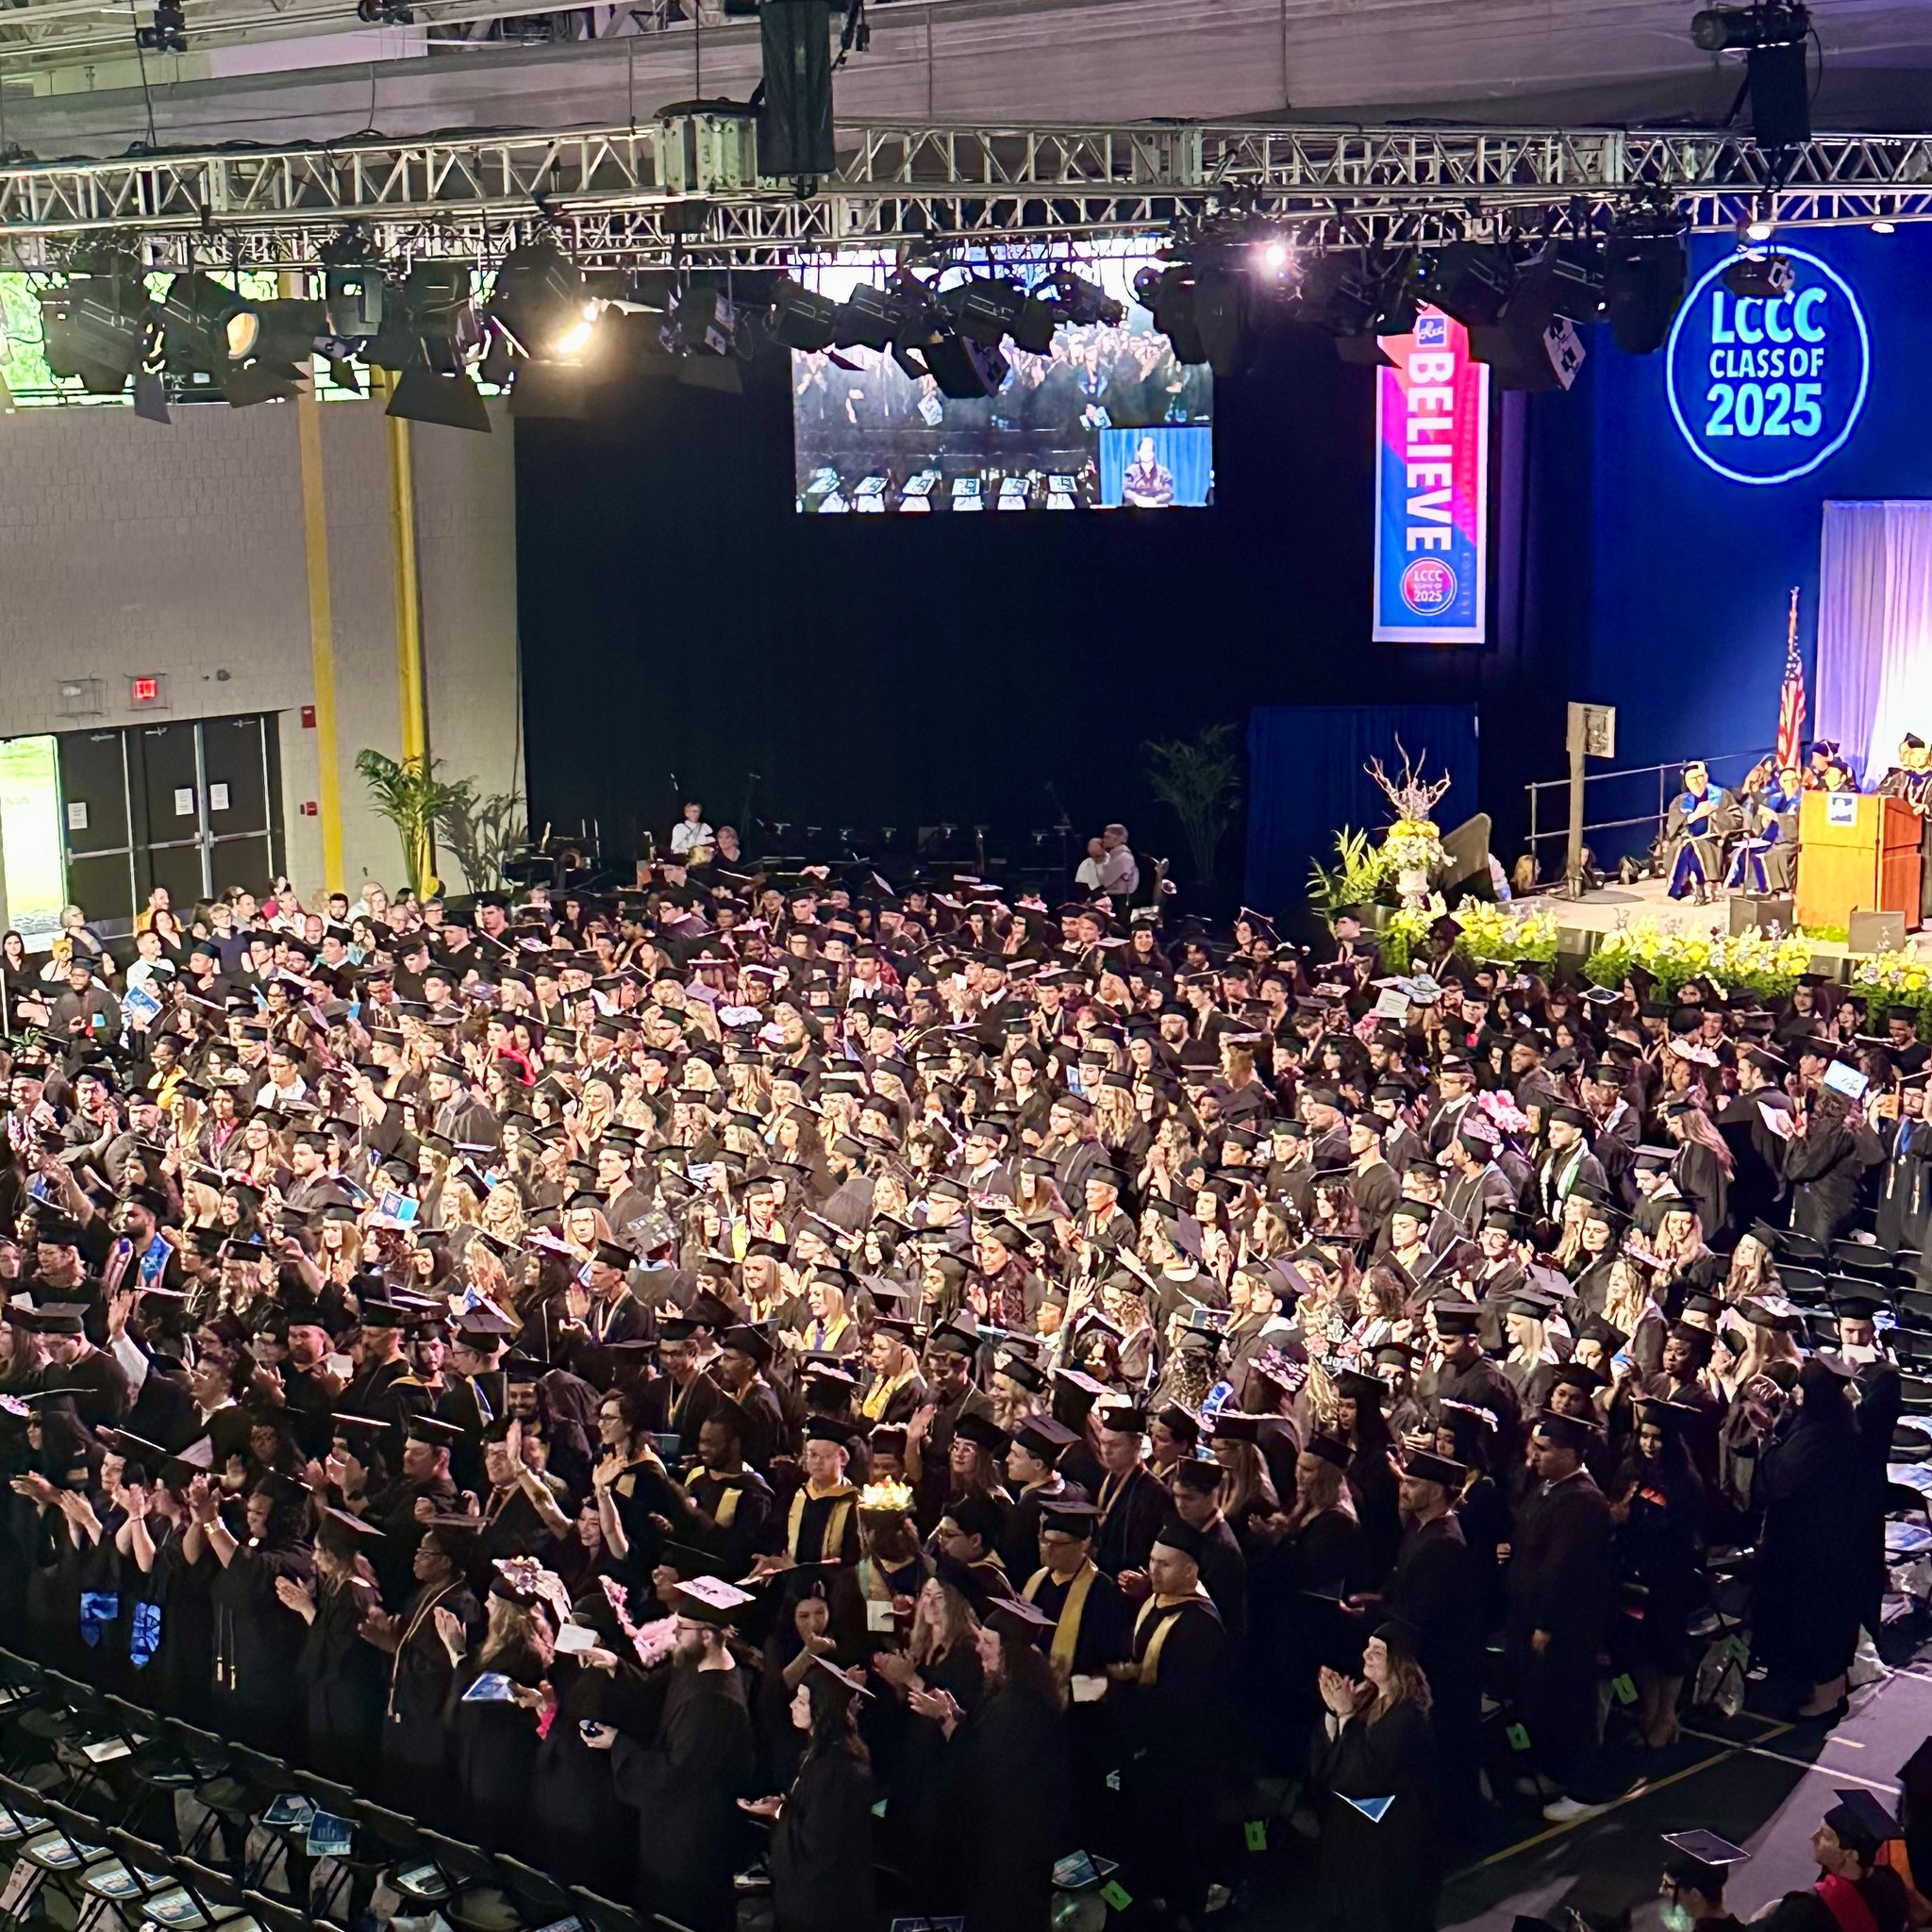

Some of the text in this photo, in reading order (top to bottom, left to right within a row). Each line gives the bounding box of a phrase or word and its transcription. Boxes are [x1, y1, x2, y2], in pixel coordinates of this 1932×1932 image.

[1711, 287, 1828, 344] LCCC
[1709, 347, 1824, 378] CLASS OF
[1706, 382, 1823, 437] 2025
[1406, 352, 1455, 552] BELIEVE
[1413, 569, 1443, 582] LCCC
[1413, 590, 1442, 602] 2025
